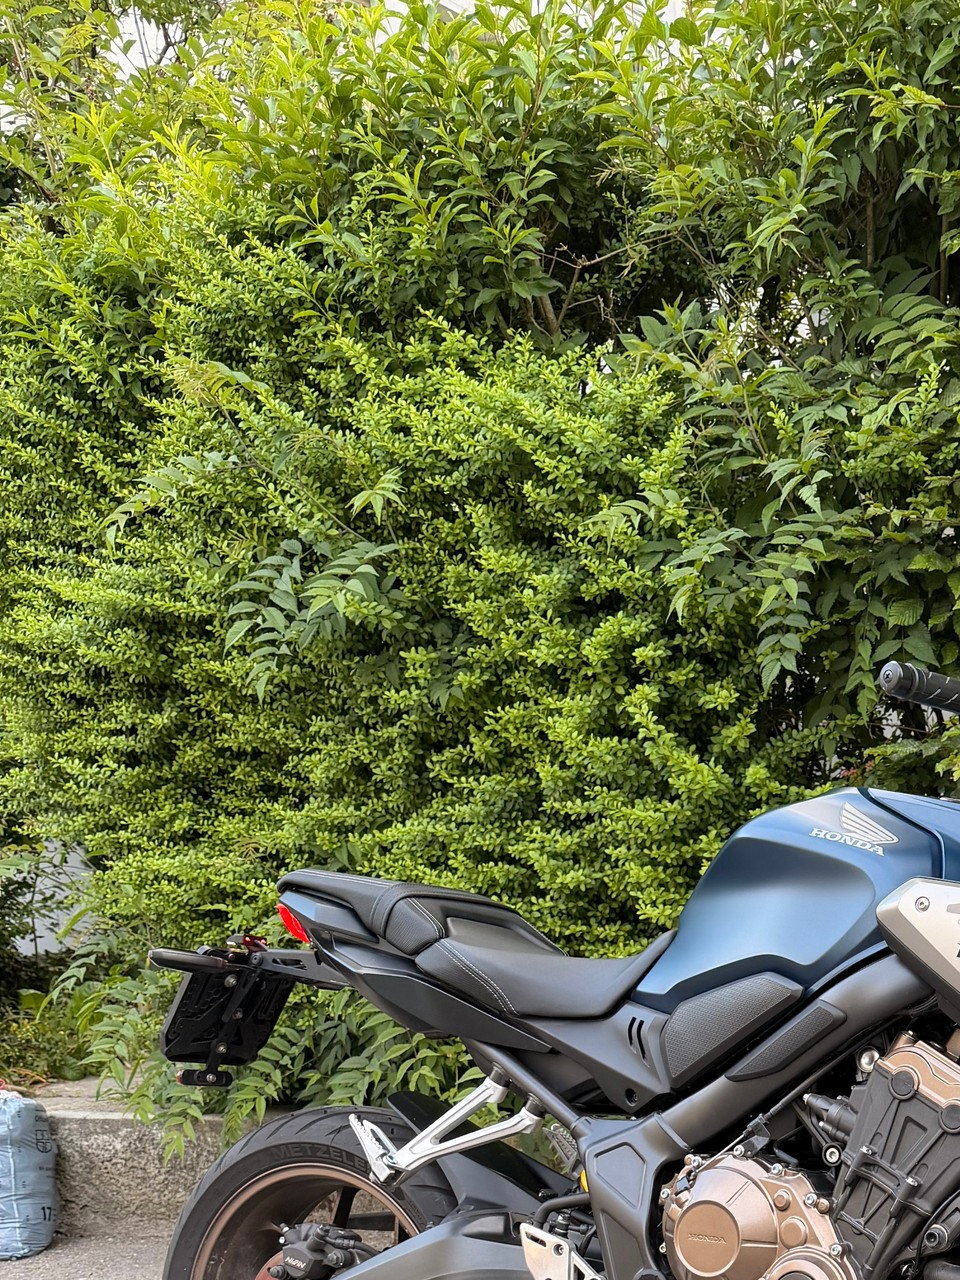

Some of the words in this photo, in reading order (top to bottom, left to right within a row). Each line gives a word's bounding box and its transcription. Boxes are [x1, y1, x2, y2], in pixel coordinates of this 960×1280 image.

[808, 827, 884, 857] HONDA
[271, 1143, 370, 1174] METZELE
[41, 1205, 53, 1222] 17
[687, 1232, 728, 1245] HONDA
